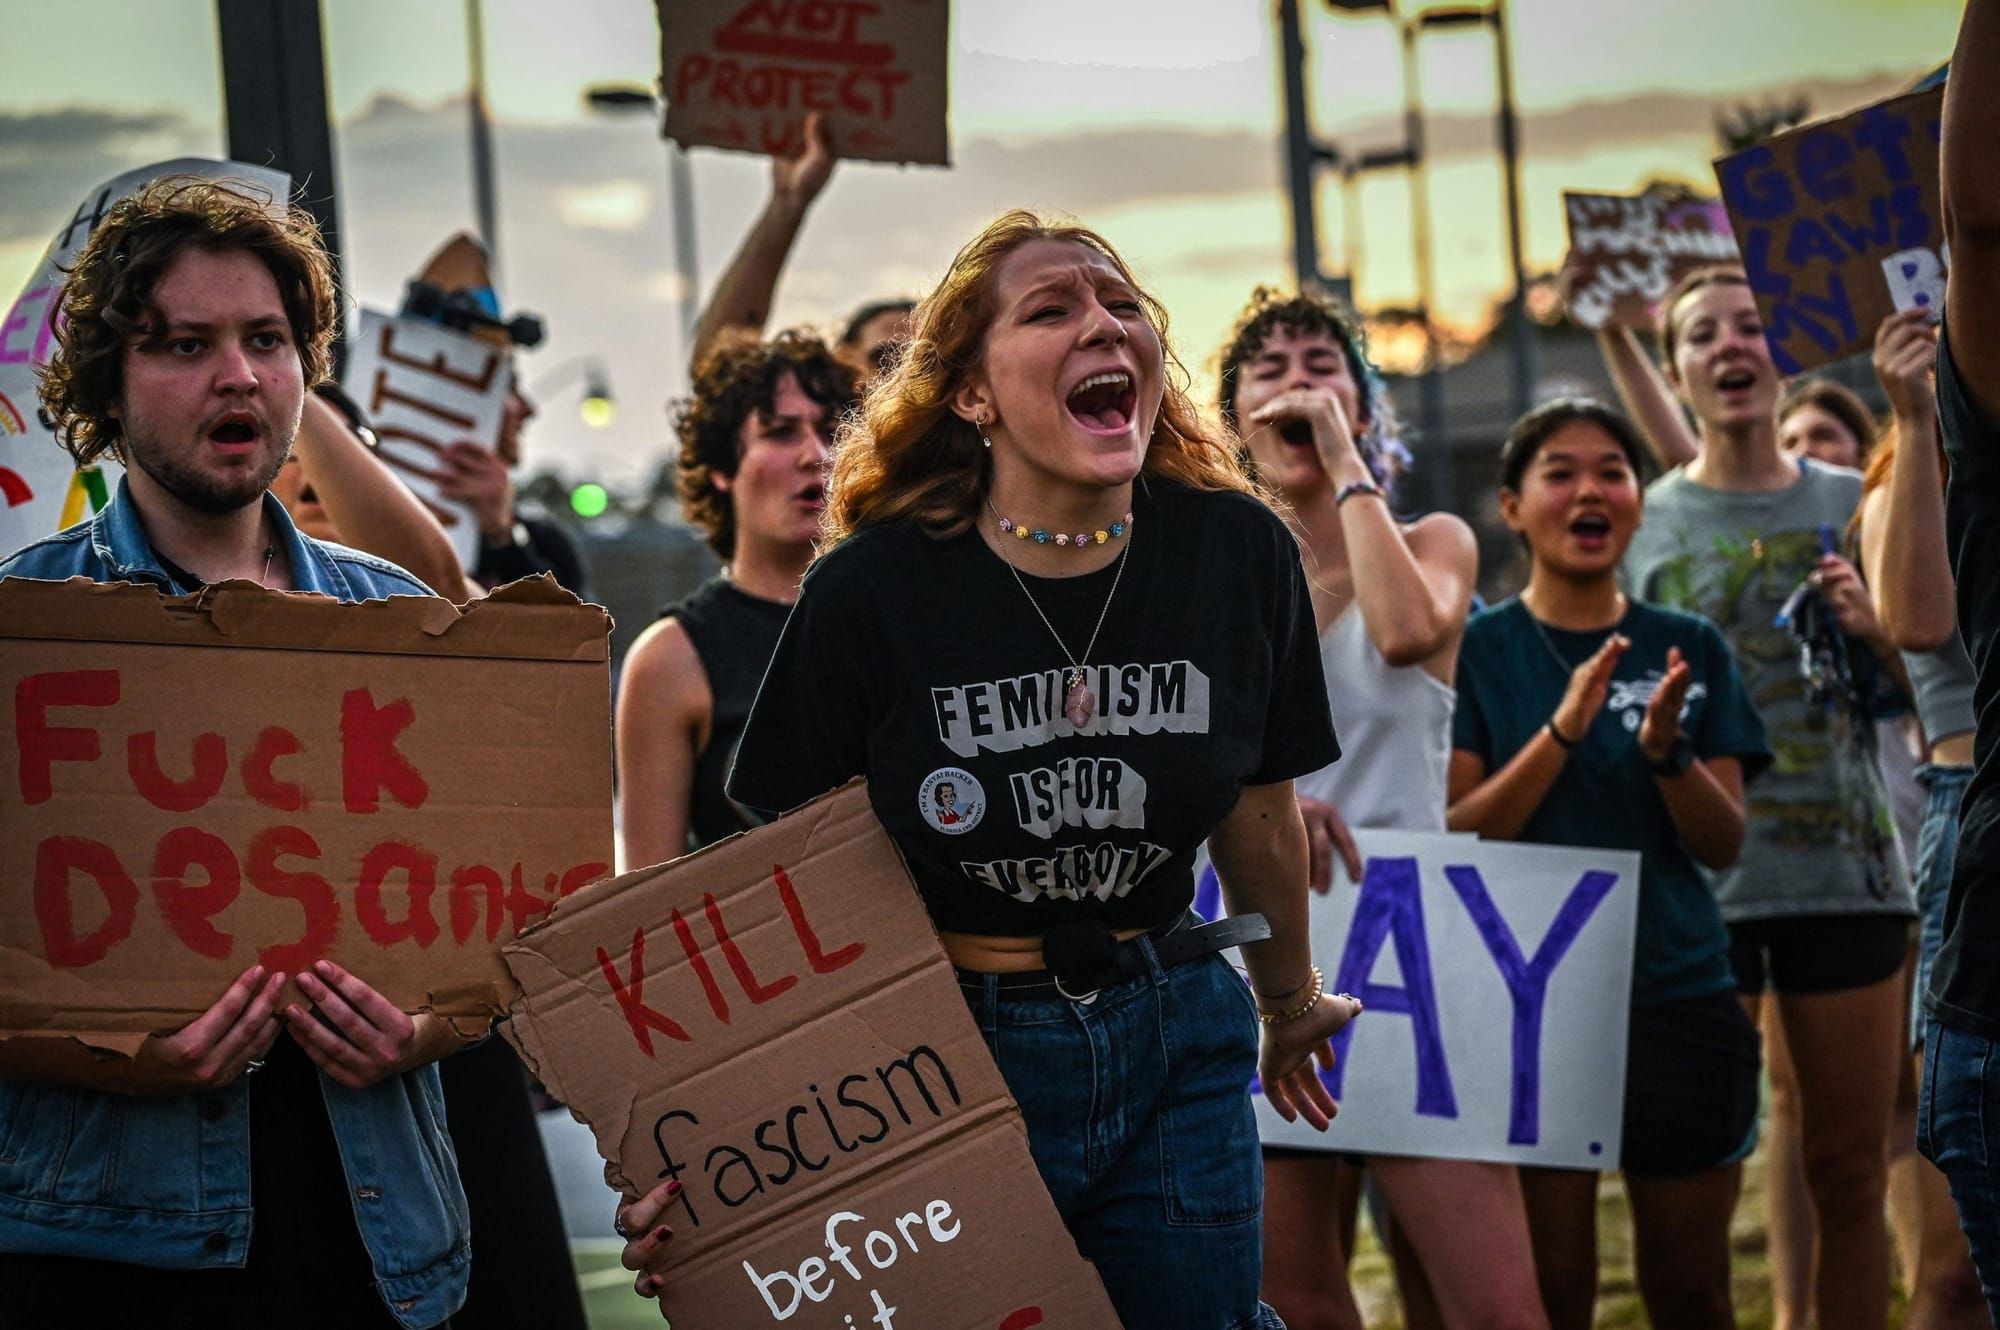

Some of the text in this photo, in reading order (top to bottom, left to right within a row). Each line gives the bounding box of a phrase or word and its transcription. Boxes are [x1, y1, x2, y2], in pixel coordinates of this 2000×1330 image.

[730, 0, 884, 45] NOT
[675, 52, 914, 119] PROTECT
[1745, 185, 1932, 297] LAWS
[1765, 272, 1859, 377] MY
[596, 864, 867, 1058] KILL
[652, 1043, 961, 1227] fascism
[743, 1198, 962, 1322] before
